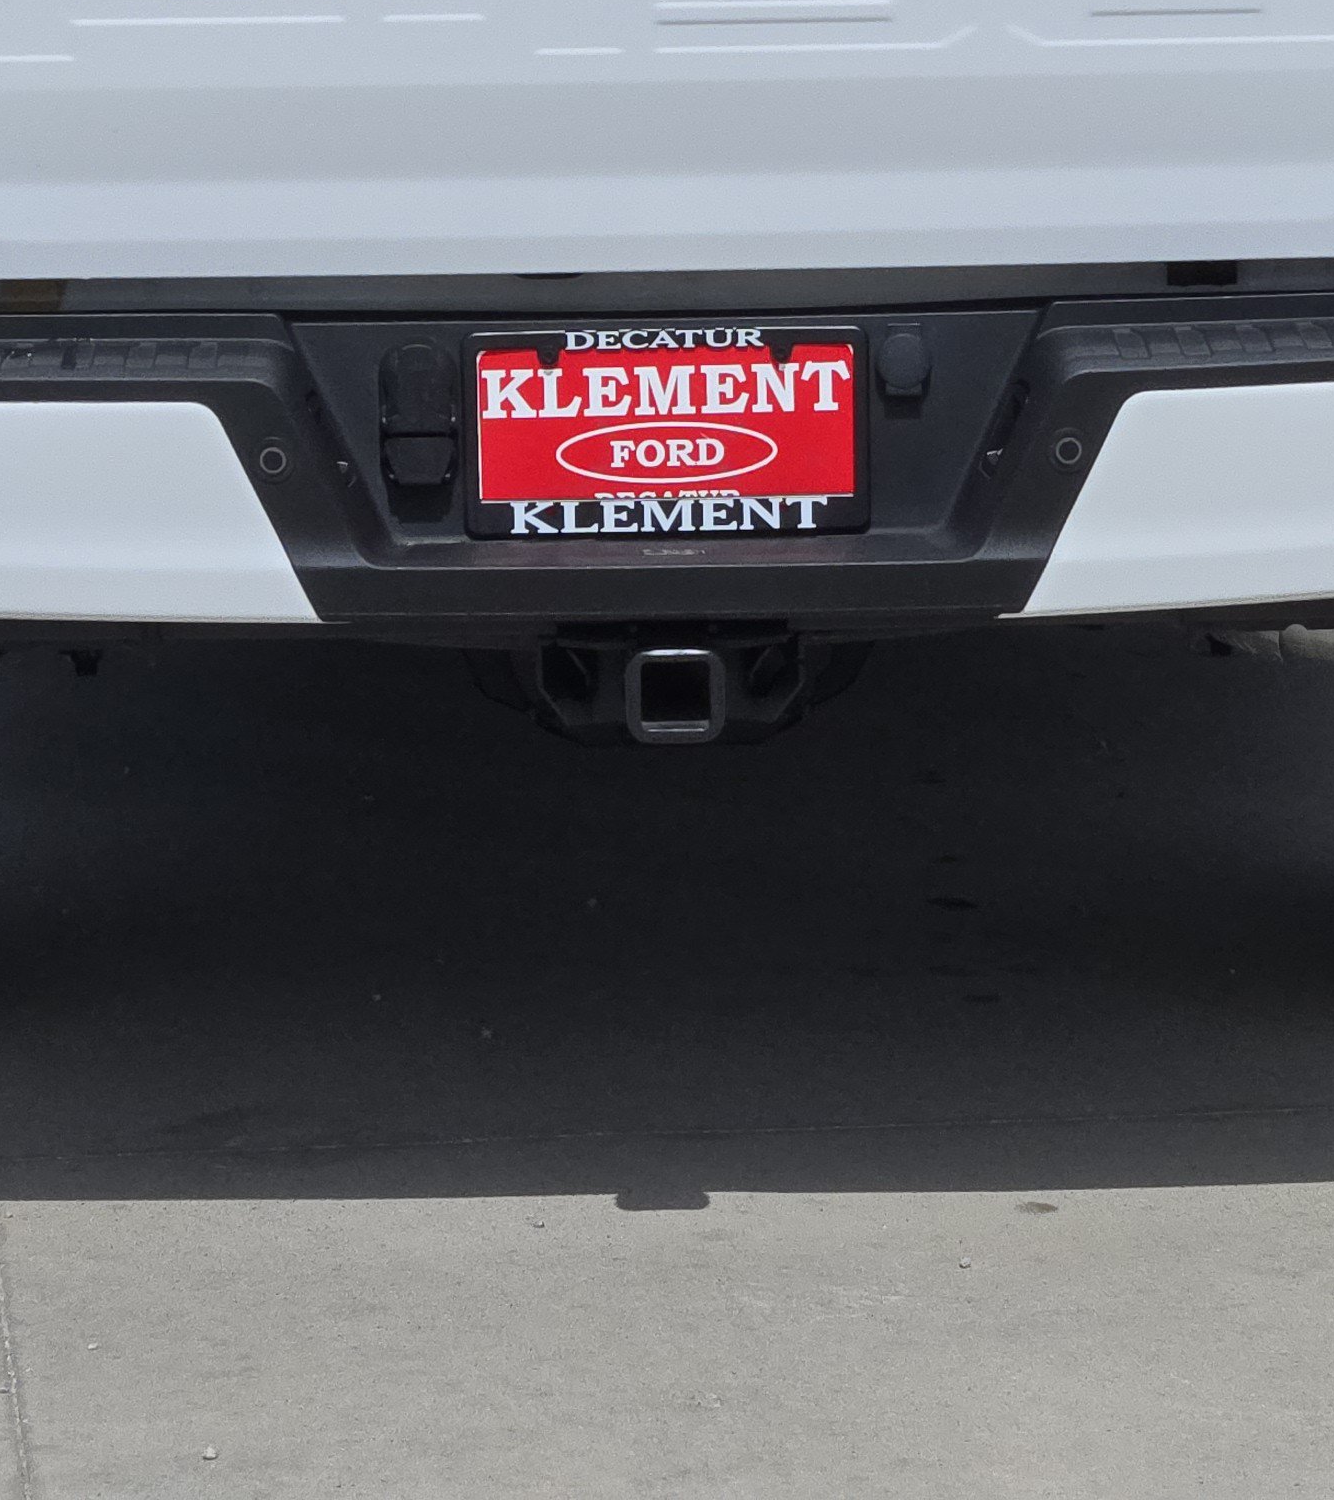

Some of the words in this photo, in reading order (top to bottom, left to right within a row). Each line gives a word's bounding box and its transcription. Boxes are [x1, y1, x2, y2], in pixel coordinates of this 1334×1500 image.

[564, 327, 765, 351] DECATUR
[481, 360, 851, 421] KLEMENT
[610, 438, 726, 469] FORD
[509, 496, 829, 535] KLEMENT
